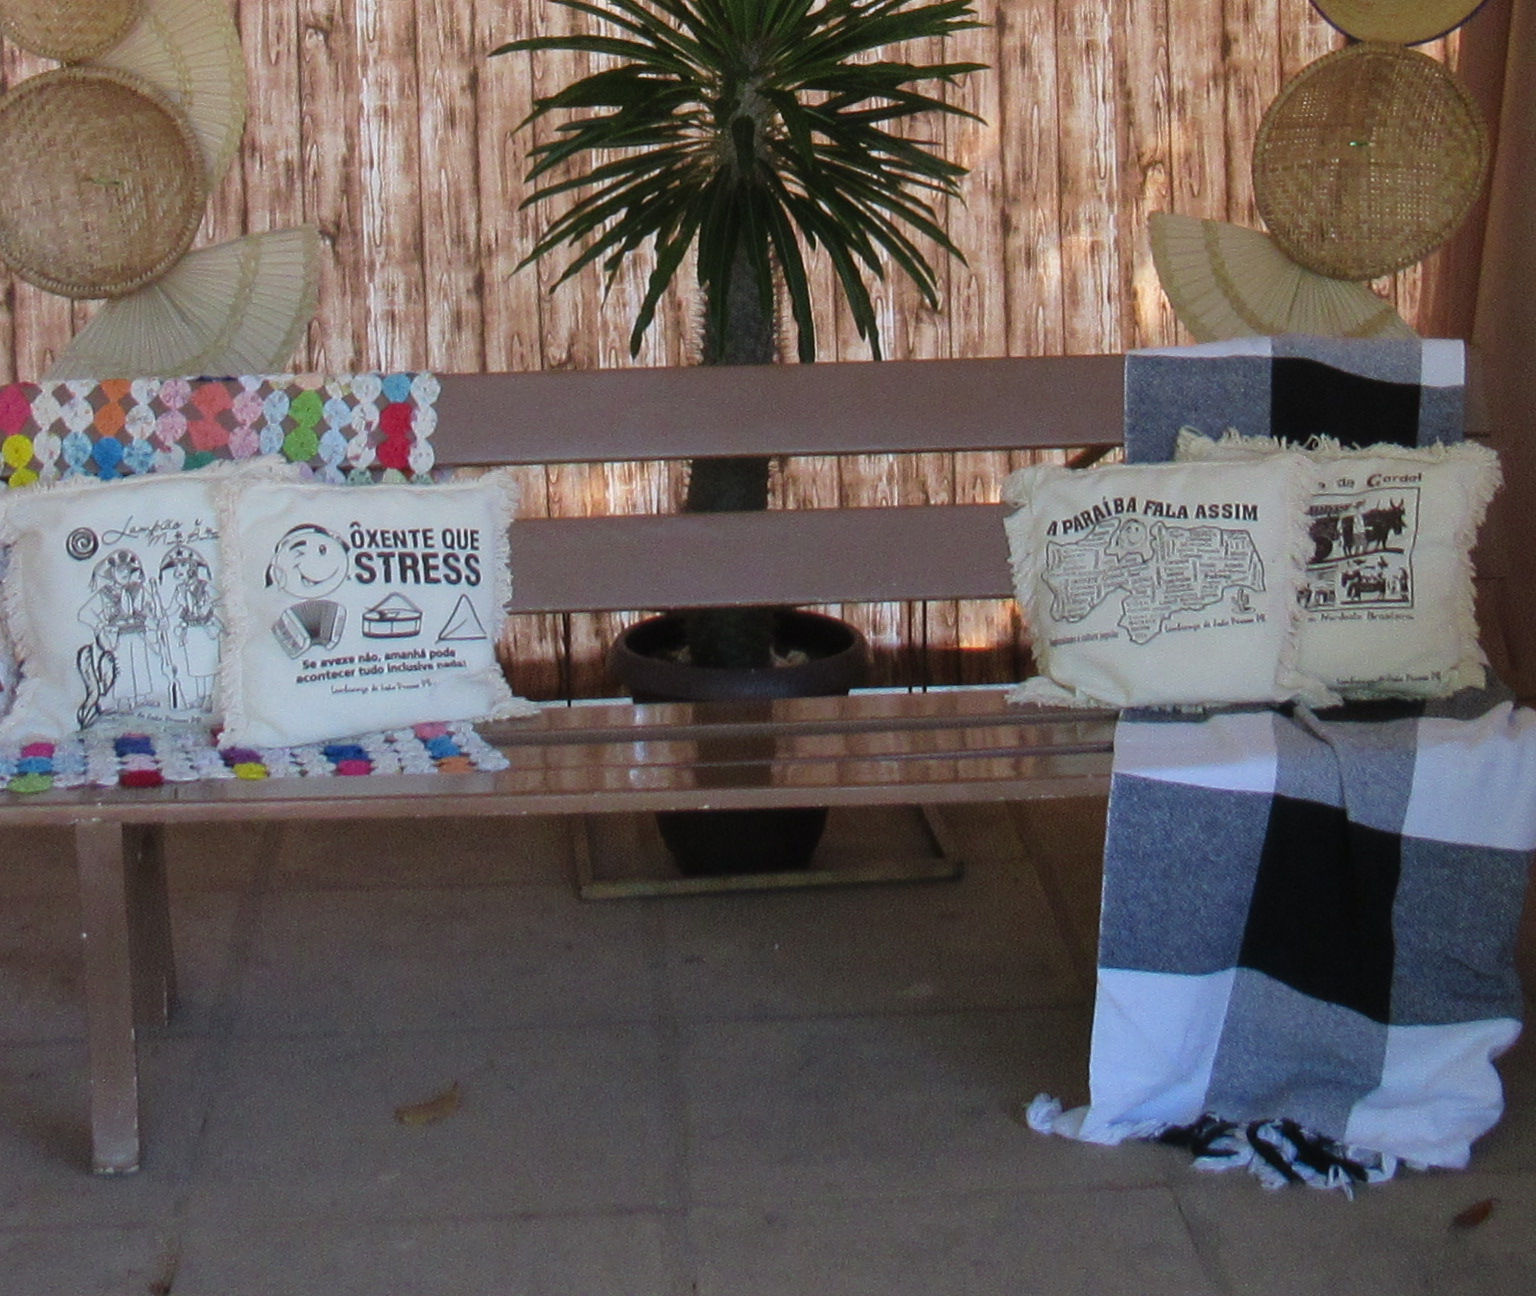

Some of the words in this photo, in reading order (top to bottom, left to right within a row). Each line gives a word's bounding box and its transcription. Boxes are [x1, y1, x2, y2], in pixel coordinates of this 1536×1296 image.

[1047, 521, 1058, 536] A
[1063, 497, 1137, 534] PARAÍBA
[1143, 500, 1188, 519] FALA
[1195, 504, 1258, 521] ASSIM
[350, 521, 435, 549] ÔXENTE
[442, 528, 479, 550] QUE
[355, 552, 481, 586] STRESS
[302, 659, 316, 669] Se
[321, 655, 354, 667] avexe
[430, 647, 456, 660] pode
[296, 668, 355, 684] acontecer
[359, 666, 384, 675] tudo
[387, 662, 434, 673] inclusive
